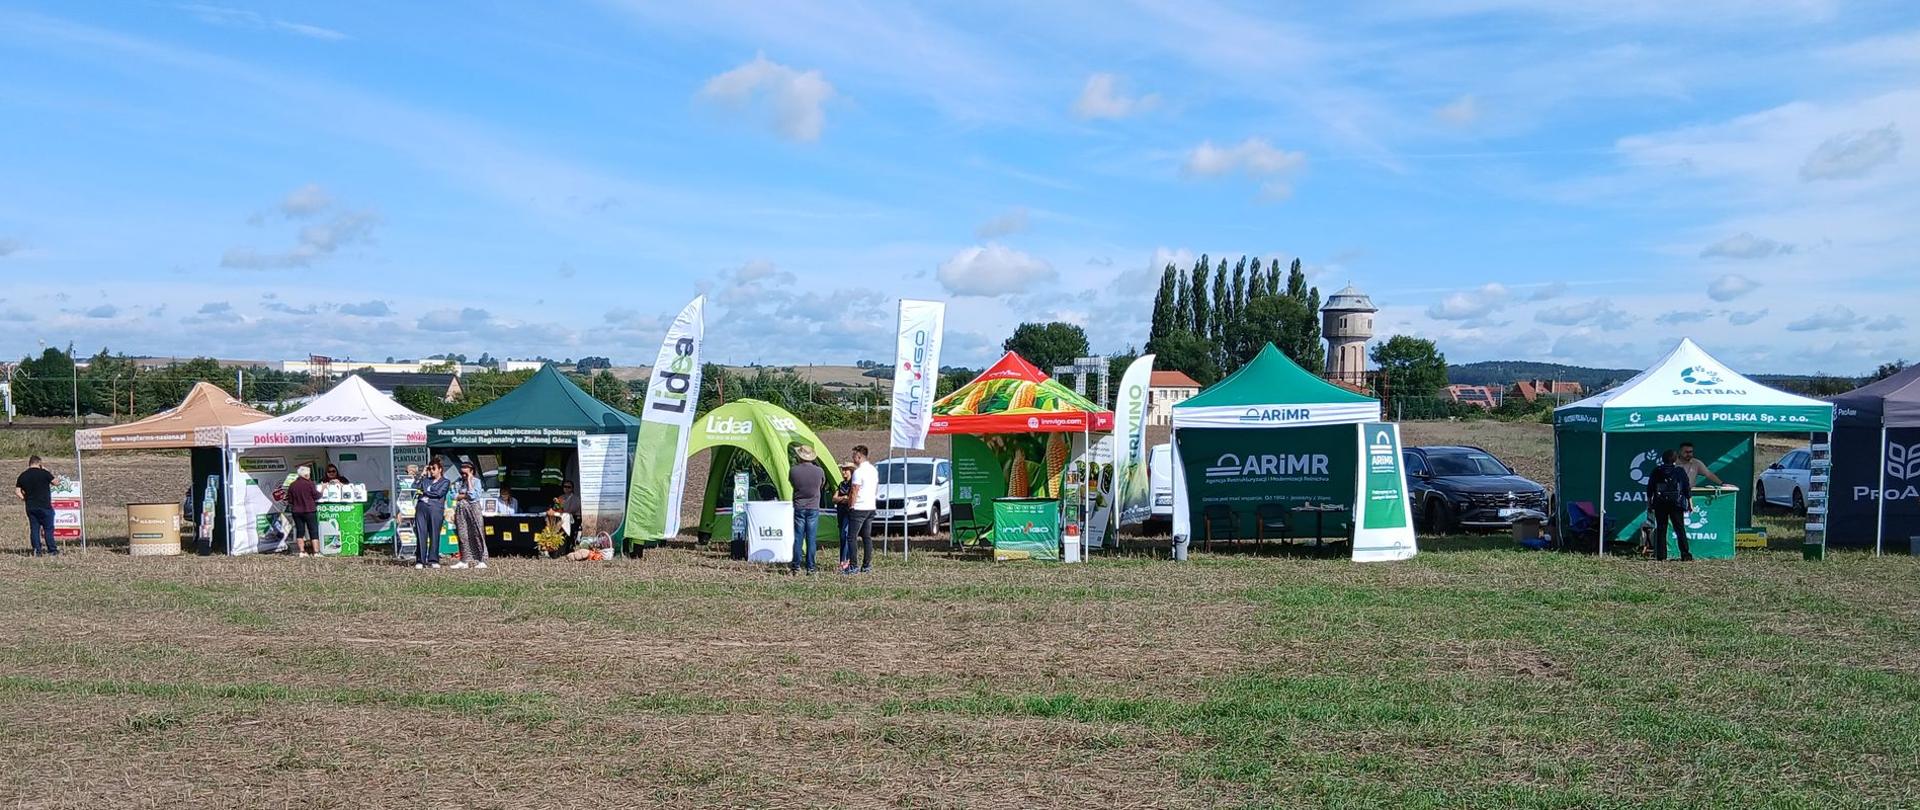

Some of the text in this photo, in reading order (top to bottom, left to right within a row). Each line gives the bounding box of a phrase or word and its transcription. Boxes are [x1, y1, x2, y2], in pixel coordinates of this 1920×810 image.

[653, 337, 693, 413] Lidea
[1261, 408, 1310, 421] ARiMR
[1657, 413, 1709, 422] SAATBAU
[1713, 413, 1757, 422] POLSKA
[1760, 413, 1777, 423] Sp.
[706, 415, 752, 434] Lidea
[456, 428, 493, 437] Rolniczego
[494, 428, 541, 437] Ubezpieczenia
[254, 432, 365, 446] polskieaminokwasy.pl
[478, 437, 515, 445] Regionalny
[524, 437, 550, 445] Zielonej
[1242, 454, 1329, 475] ARiMR
[759, 526, 783, 537] Lidea
[1672, 532, 1717, 540] SATBAU
